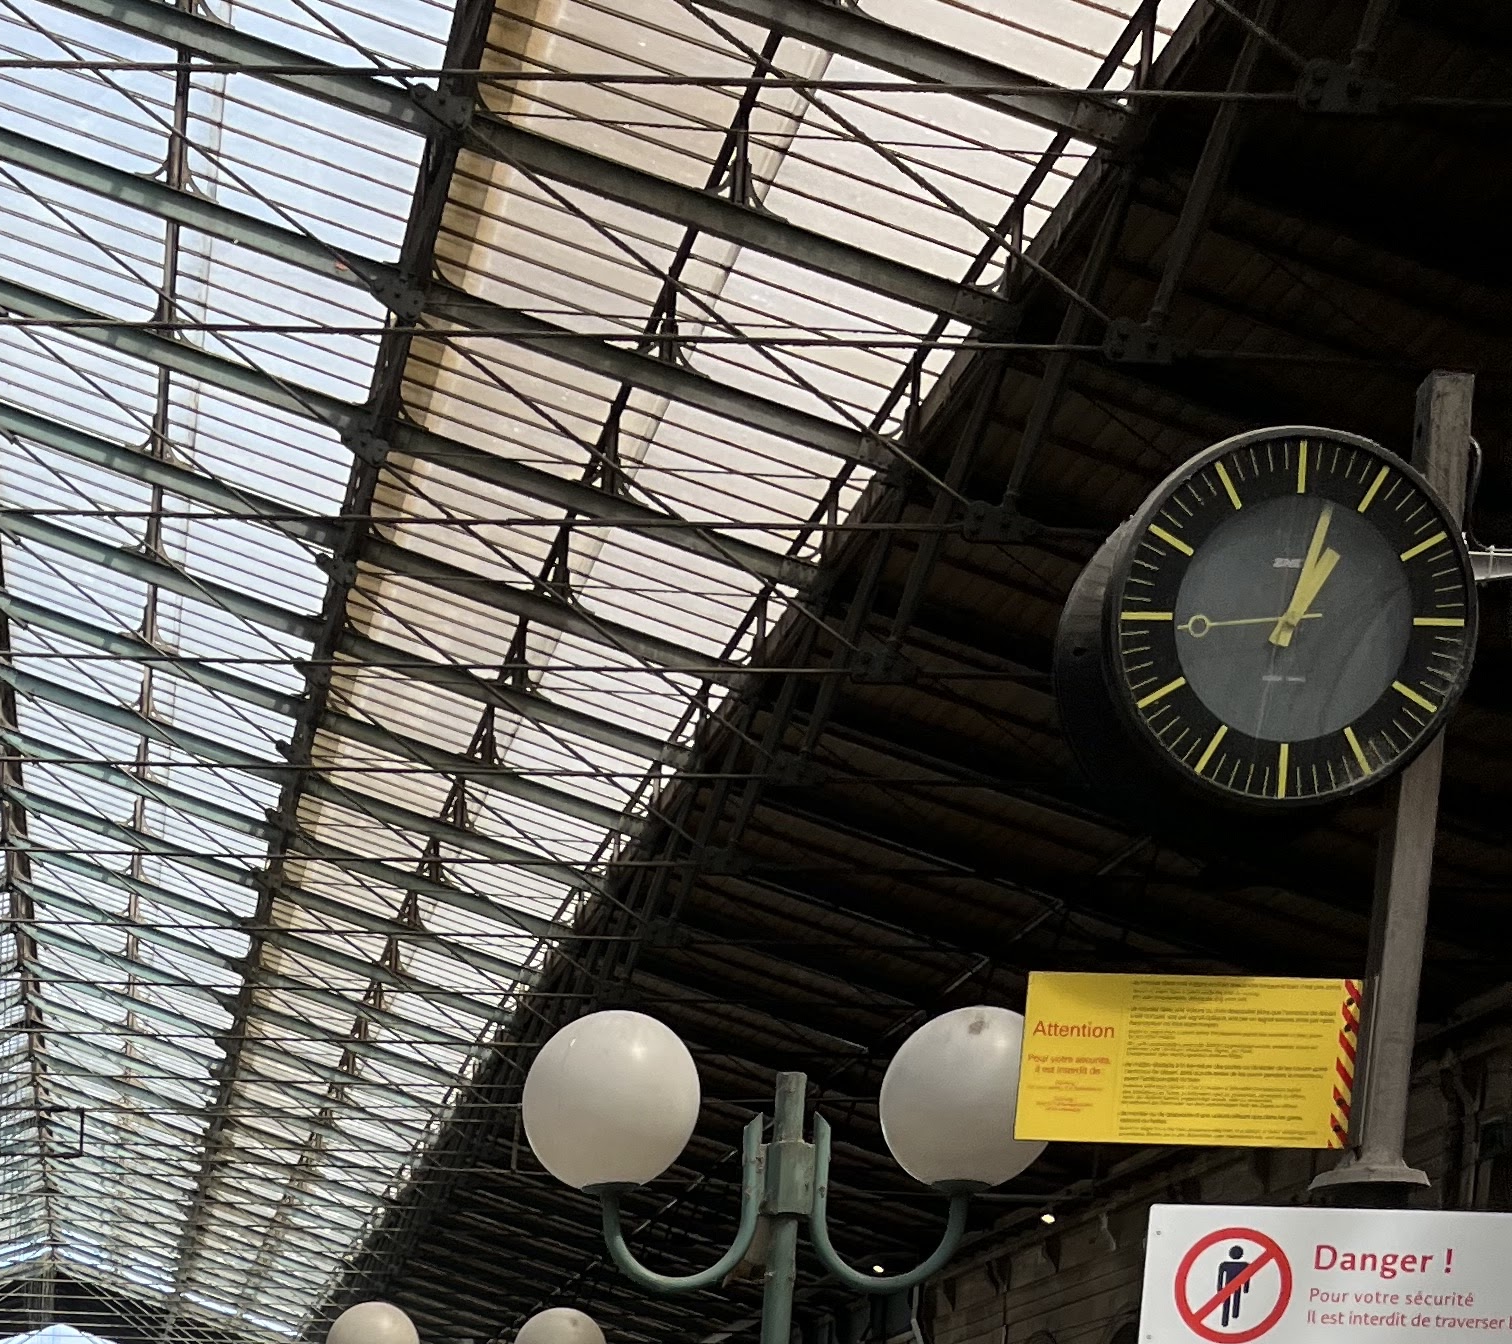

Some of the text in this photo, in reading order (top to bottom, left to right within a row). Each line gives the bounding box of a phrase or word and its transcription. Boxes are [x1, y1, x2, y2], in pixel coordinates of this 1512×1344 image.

[1033, 1020, 1115, 1038] Attention
[1314, 1244, 1453, 1280] Danger !
[1309, 1287, 1475, 1307] Pour votre sécurité
[1307, 1310, 1316, 1325] Il
[1320, 1312, 1344, 1325] est
[1348, 1311, 1407, 1327] interdit
[1411, 1312, 1431, 1327] de
[1435, 1315, 1506, 1331] traverser
